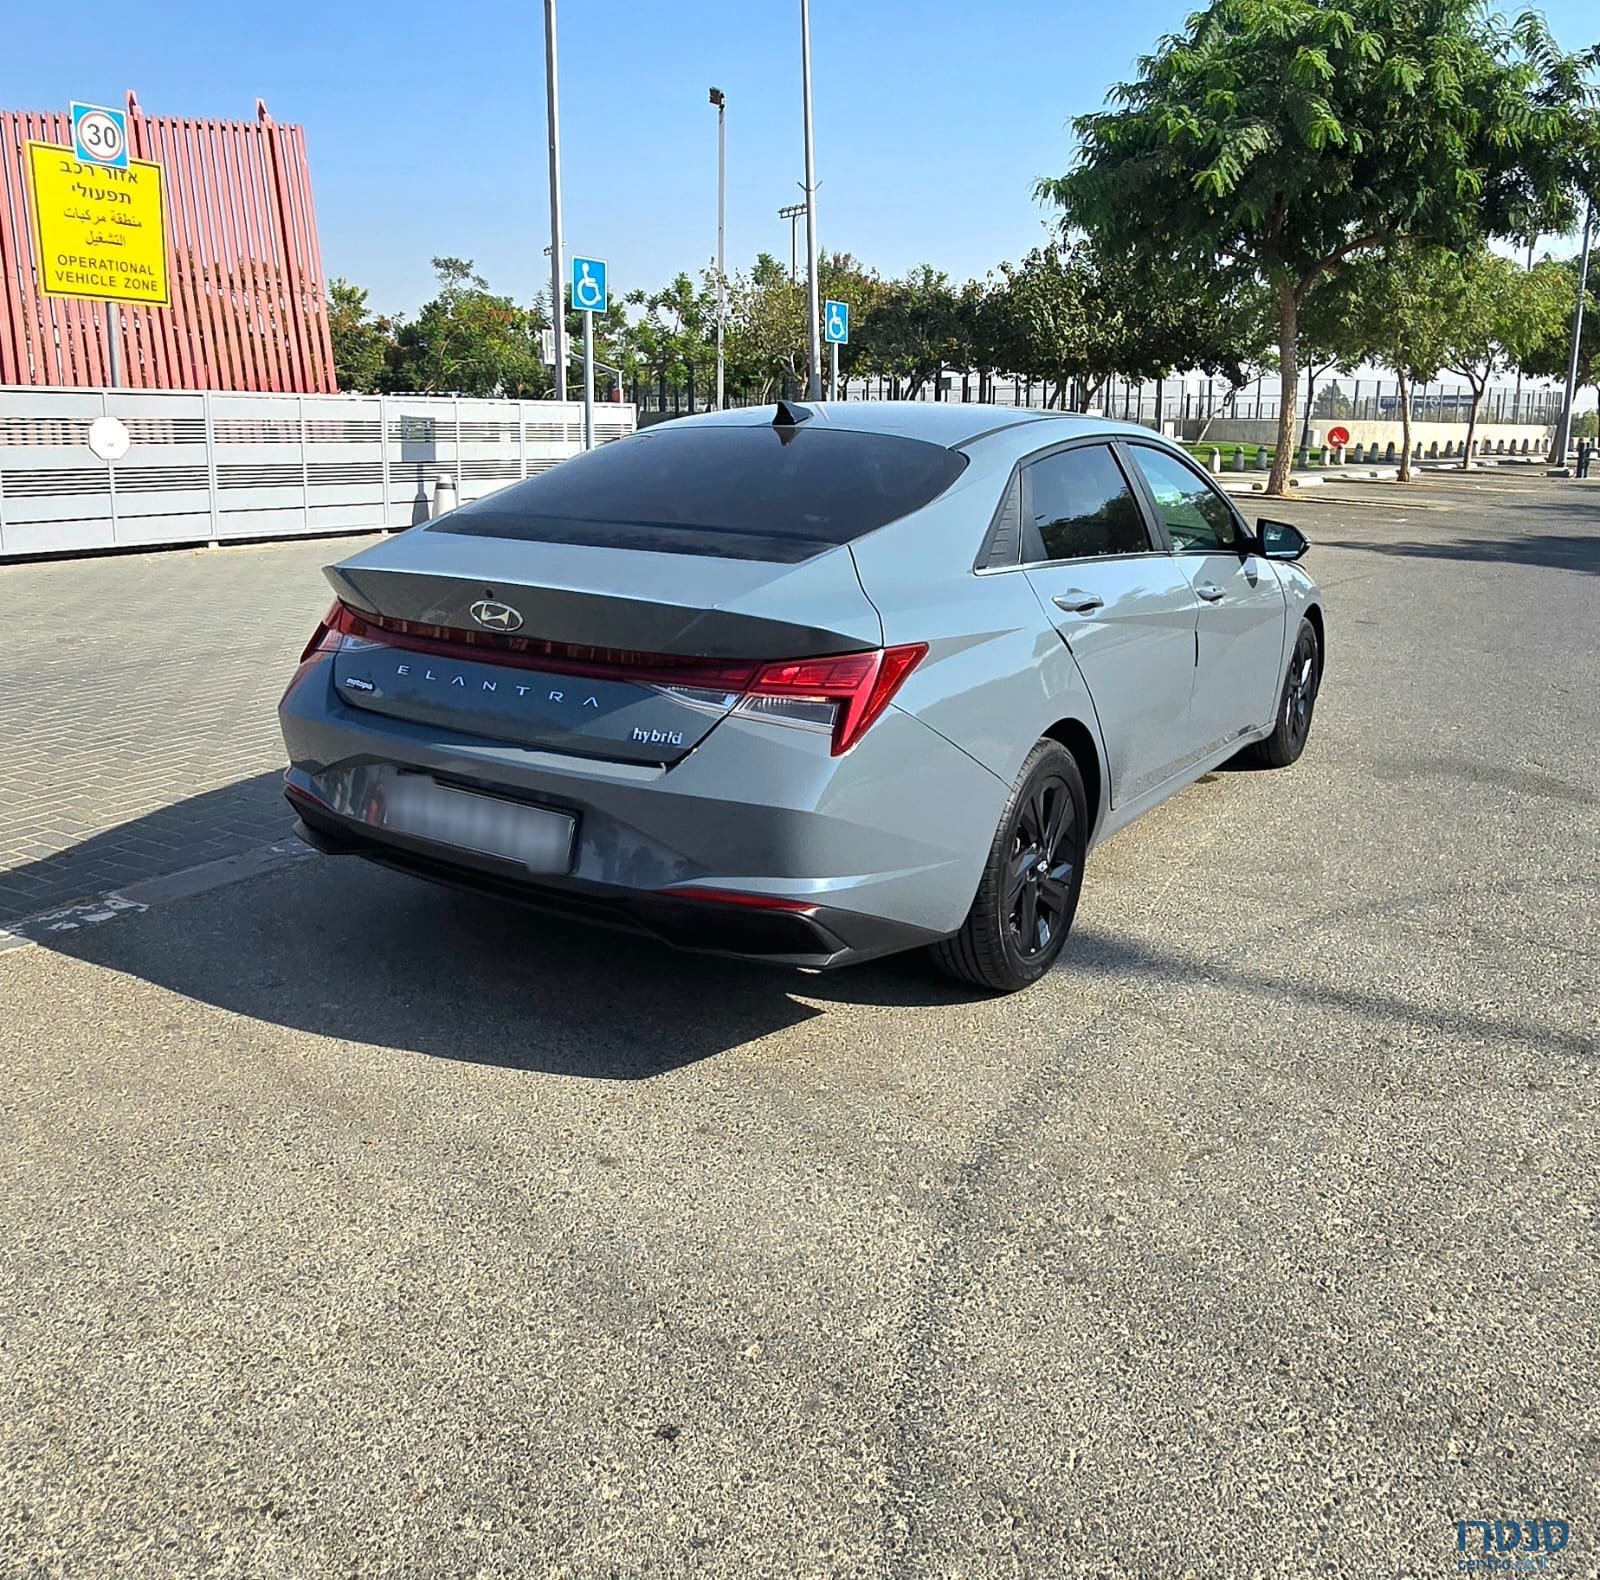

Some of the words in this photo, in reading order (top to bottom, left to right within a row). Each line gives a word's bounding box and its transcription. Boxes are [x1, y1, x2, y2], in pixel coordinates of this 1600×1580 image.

[88, 124, 116, 148] 30
[59, 161, 95, 176] רכב
[102, 167, 138, 184] אזור
[72, 182, 131, 204] תפעולי
[64, 208, 106, 224] مركبات
[110, 210, 142, 227] منطقة
[57, 254, 154, 275] OPERATIONAL
[55, 270, 116, 287] VEHICLE
[124, 278, 158, 292] ZONE
[397, 665, 599, 708] ELANTRA
[632, 727, 683, 745] hybrid
